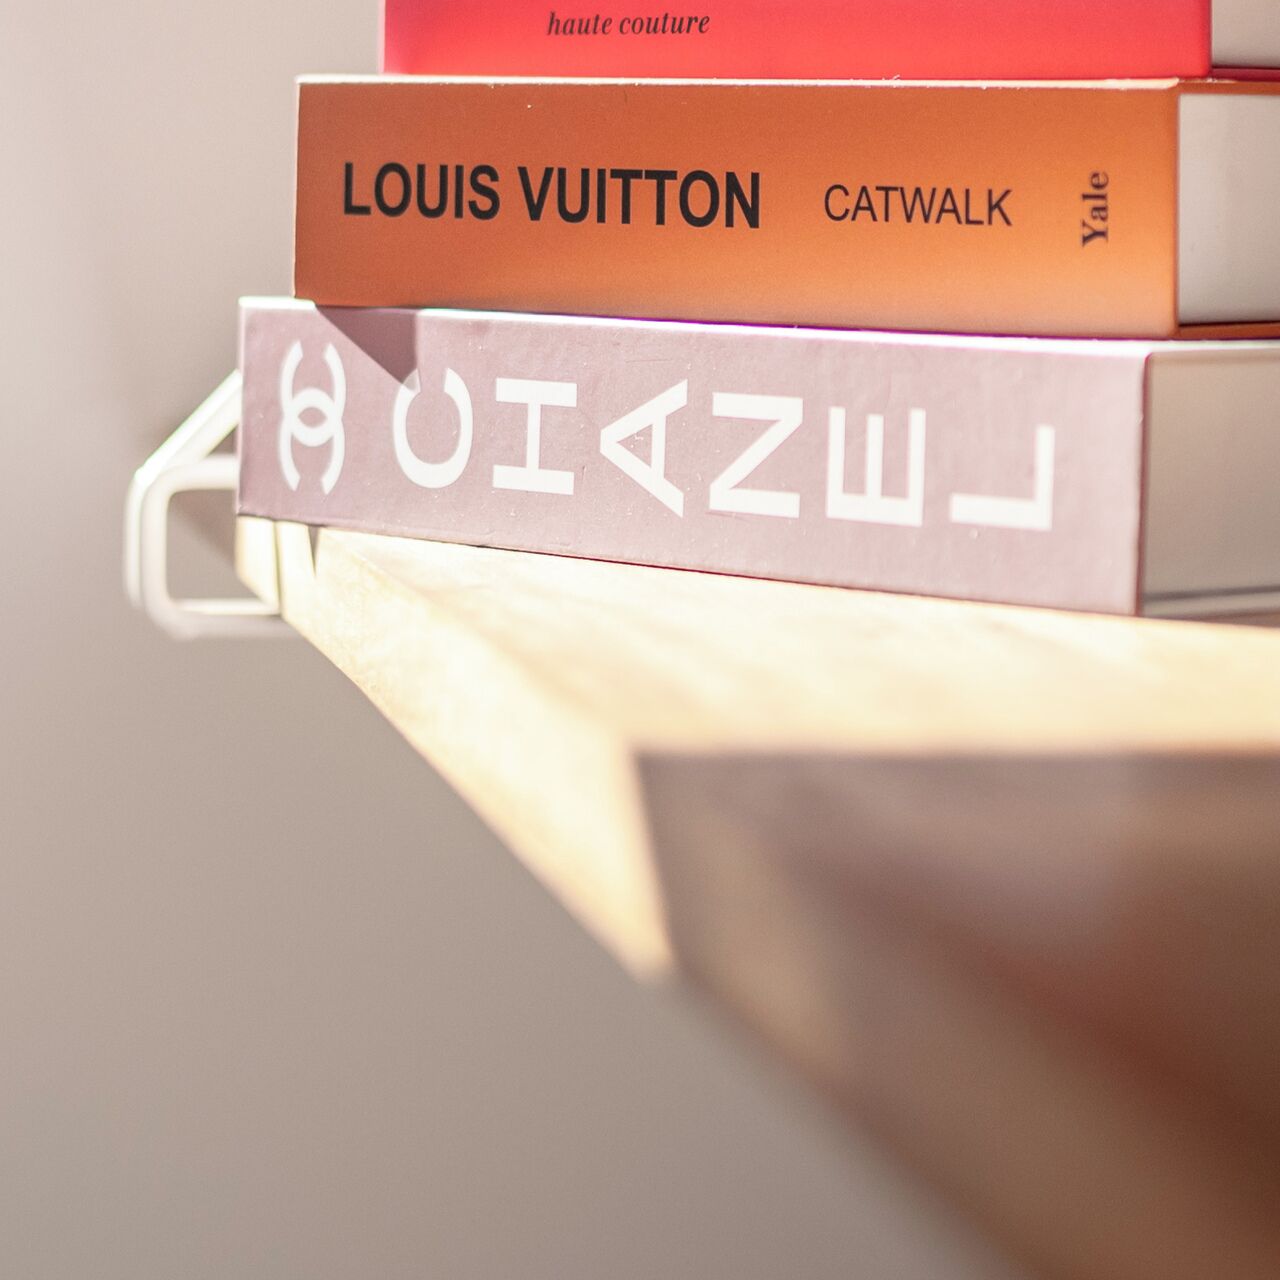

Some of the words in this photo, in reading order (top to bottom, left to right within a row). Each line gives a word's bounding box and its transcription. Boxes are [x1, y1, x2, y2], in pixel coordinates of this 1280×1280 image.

[547, 11, 612, 36] haute
[619, 13, 711, 36] couture
[343, 162, 501, 221] LOUIS
[517, 166, 761, 230] VUITTON
[823, 183, 1013, 227] CATWALK
[1081, 170, 1110, 247] Yale
[391, 366, 1056, 530] CHANEL
